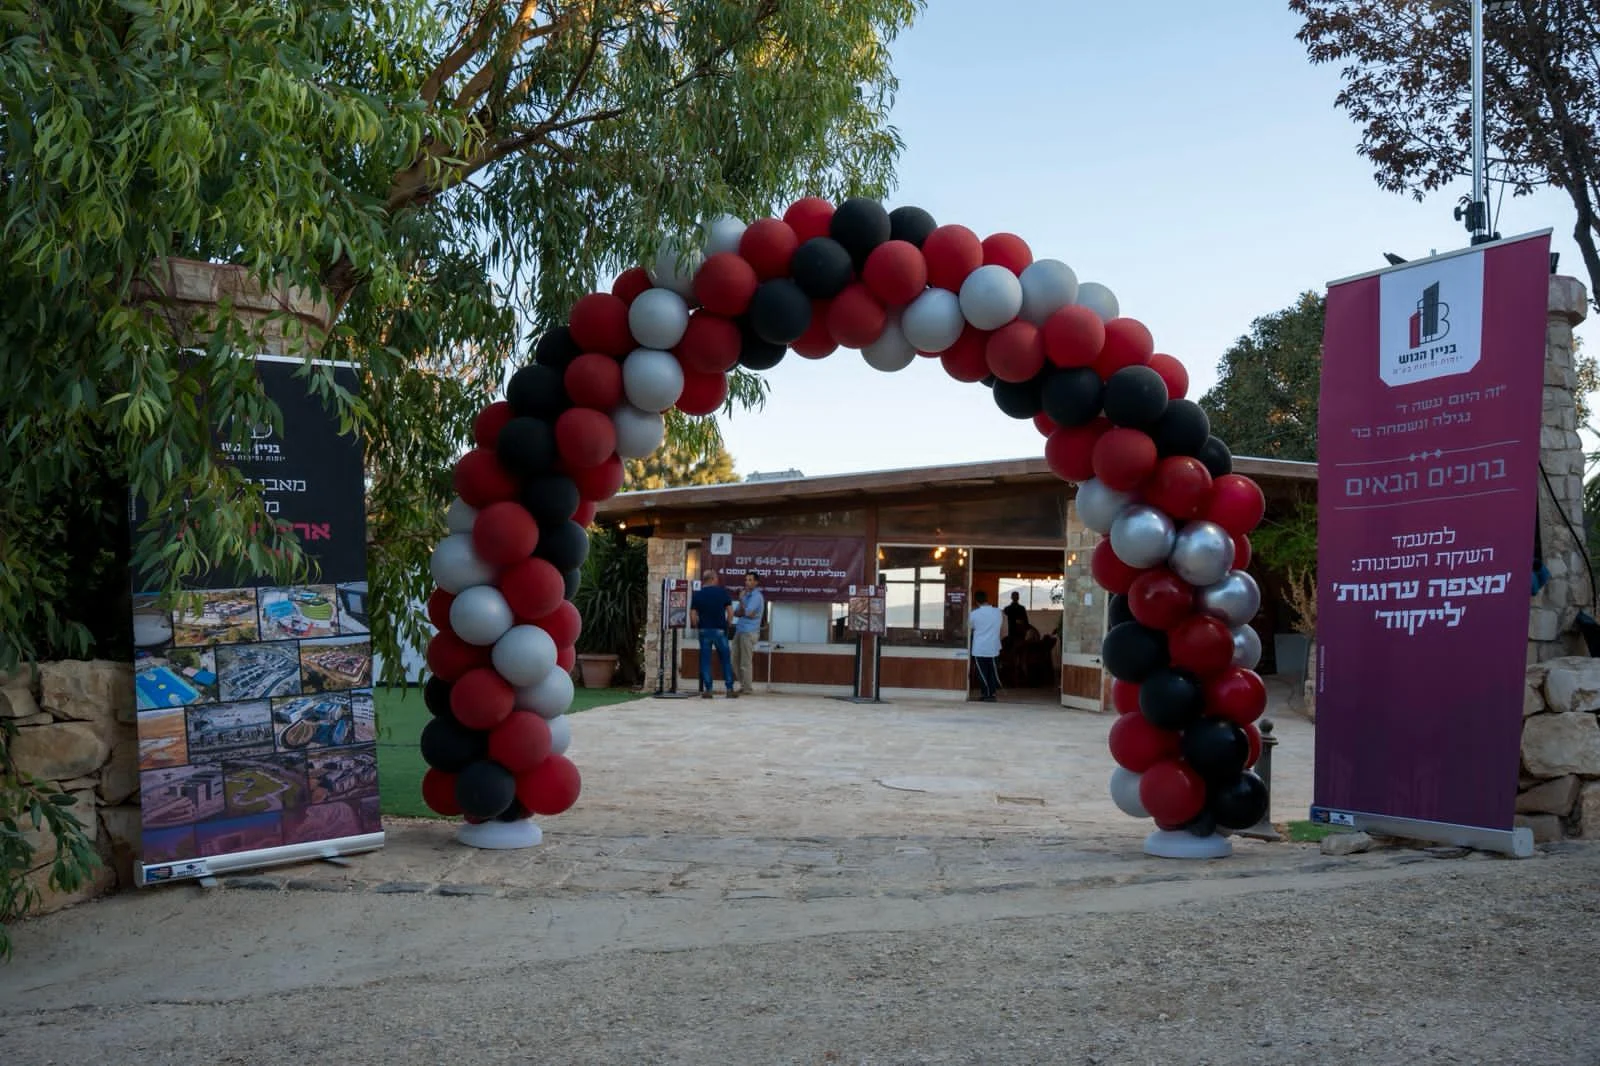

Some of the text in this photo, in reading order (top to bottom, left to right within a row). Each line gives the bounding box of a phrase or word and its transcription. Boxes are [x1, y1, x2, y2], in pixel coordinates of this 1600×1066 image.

[1398, 343, 1457, 365] בניין הגוש
[1448, 390, 1480, 406] היום
[1376, 418, 1429, 437] ונשמחה
[1432, 410, 1472, 427] נגילה
[255, 442, 281, 455] בניין
[1345, 458, 1506, 497] ברוכים הבאים
[1392, 526, 1456, 549] למעמד
[1351, 547, 1494, 572] השקת השכונות:
[1332, 572, 1512, 602] 'מצפה ערוגות'
